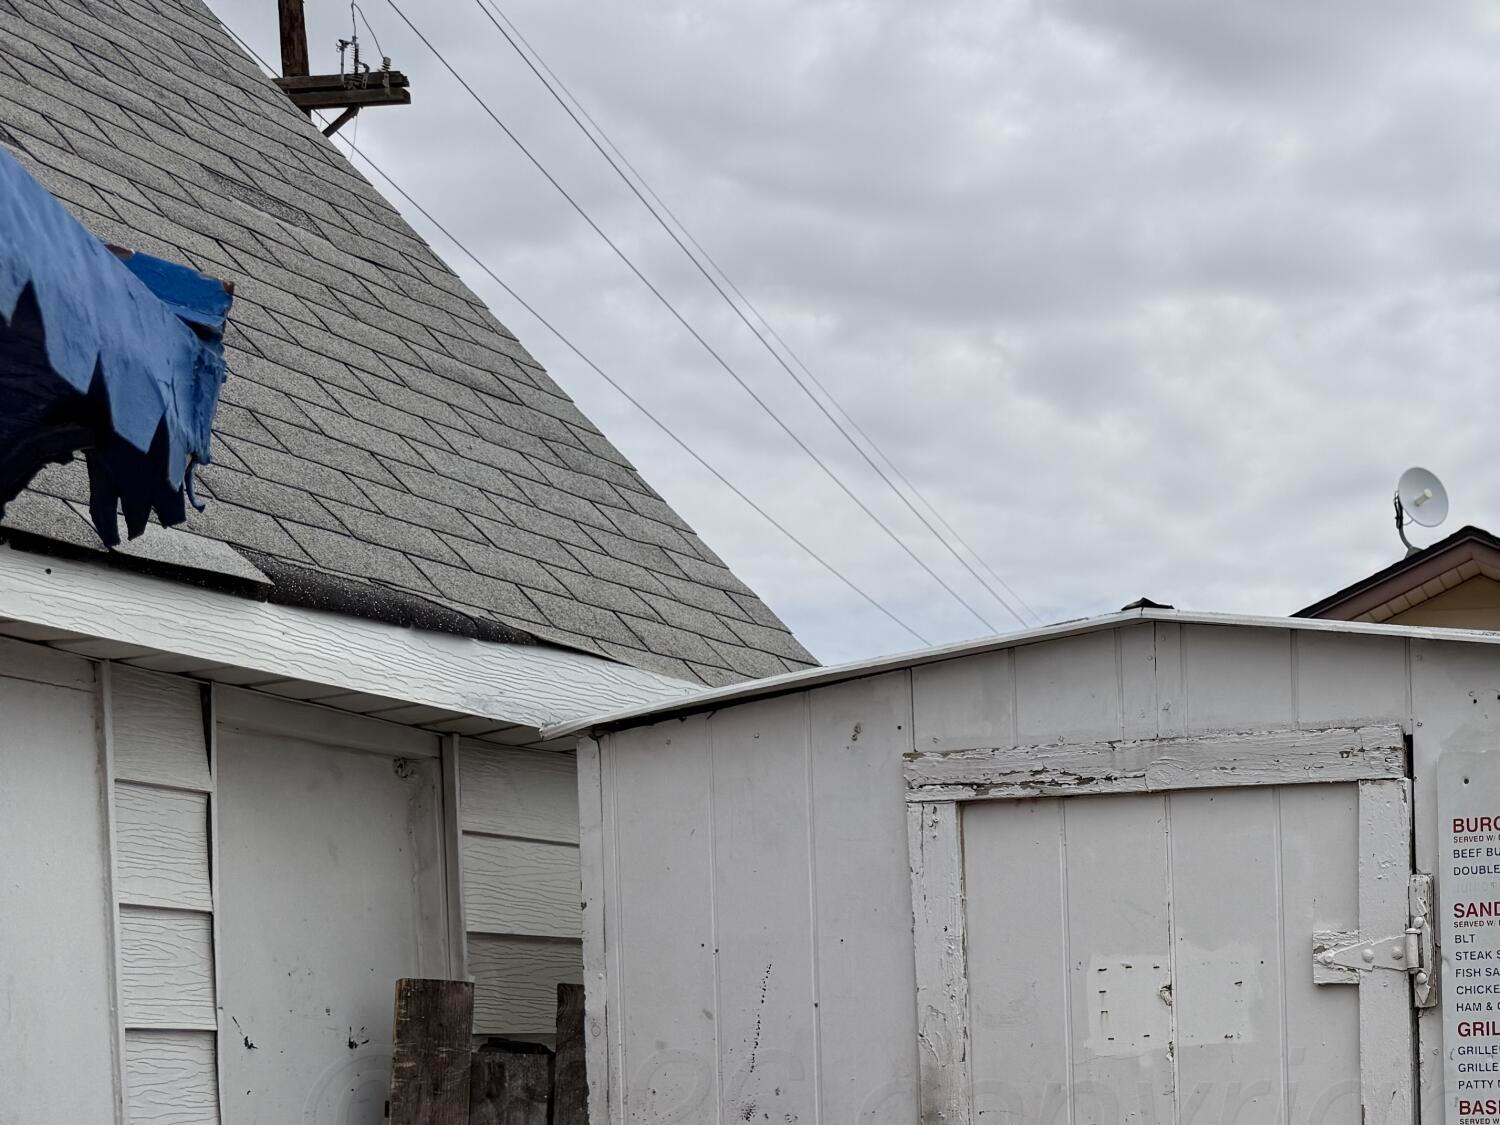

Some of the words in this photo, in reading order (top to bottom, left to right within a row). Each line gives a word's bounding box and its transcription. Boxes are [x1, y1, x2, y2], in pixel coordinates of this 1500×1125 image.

[1453, 835, 1484, 843] SERVED
[1453, 848, 1481, 858] BEEF
[1454, 864, 1500, 875] DOUBLE
[1454, 920, 1484, 928] SERVED
[1454, 934, 1475, 943] BLT
[1456, 950, 1492, 960] STEAK
[1456, 968, 1480, 977] FISH
[1456, 1002, 1481, 1012] HAM
[1458, 1079, 1493, 1089] PATTY
